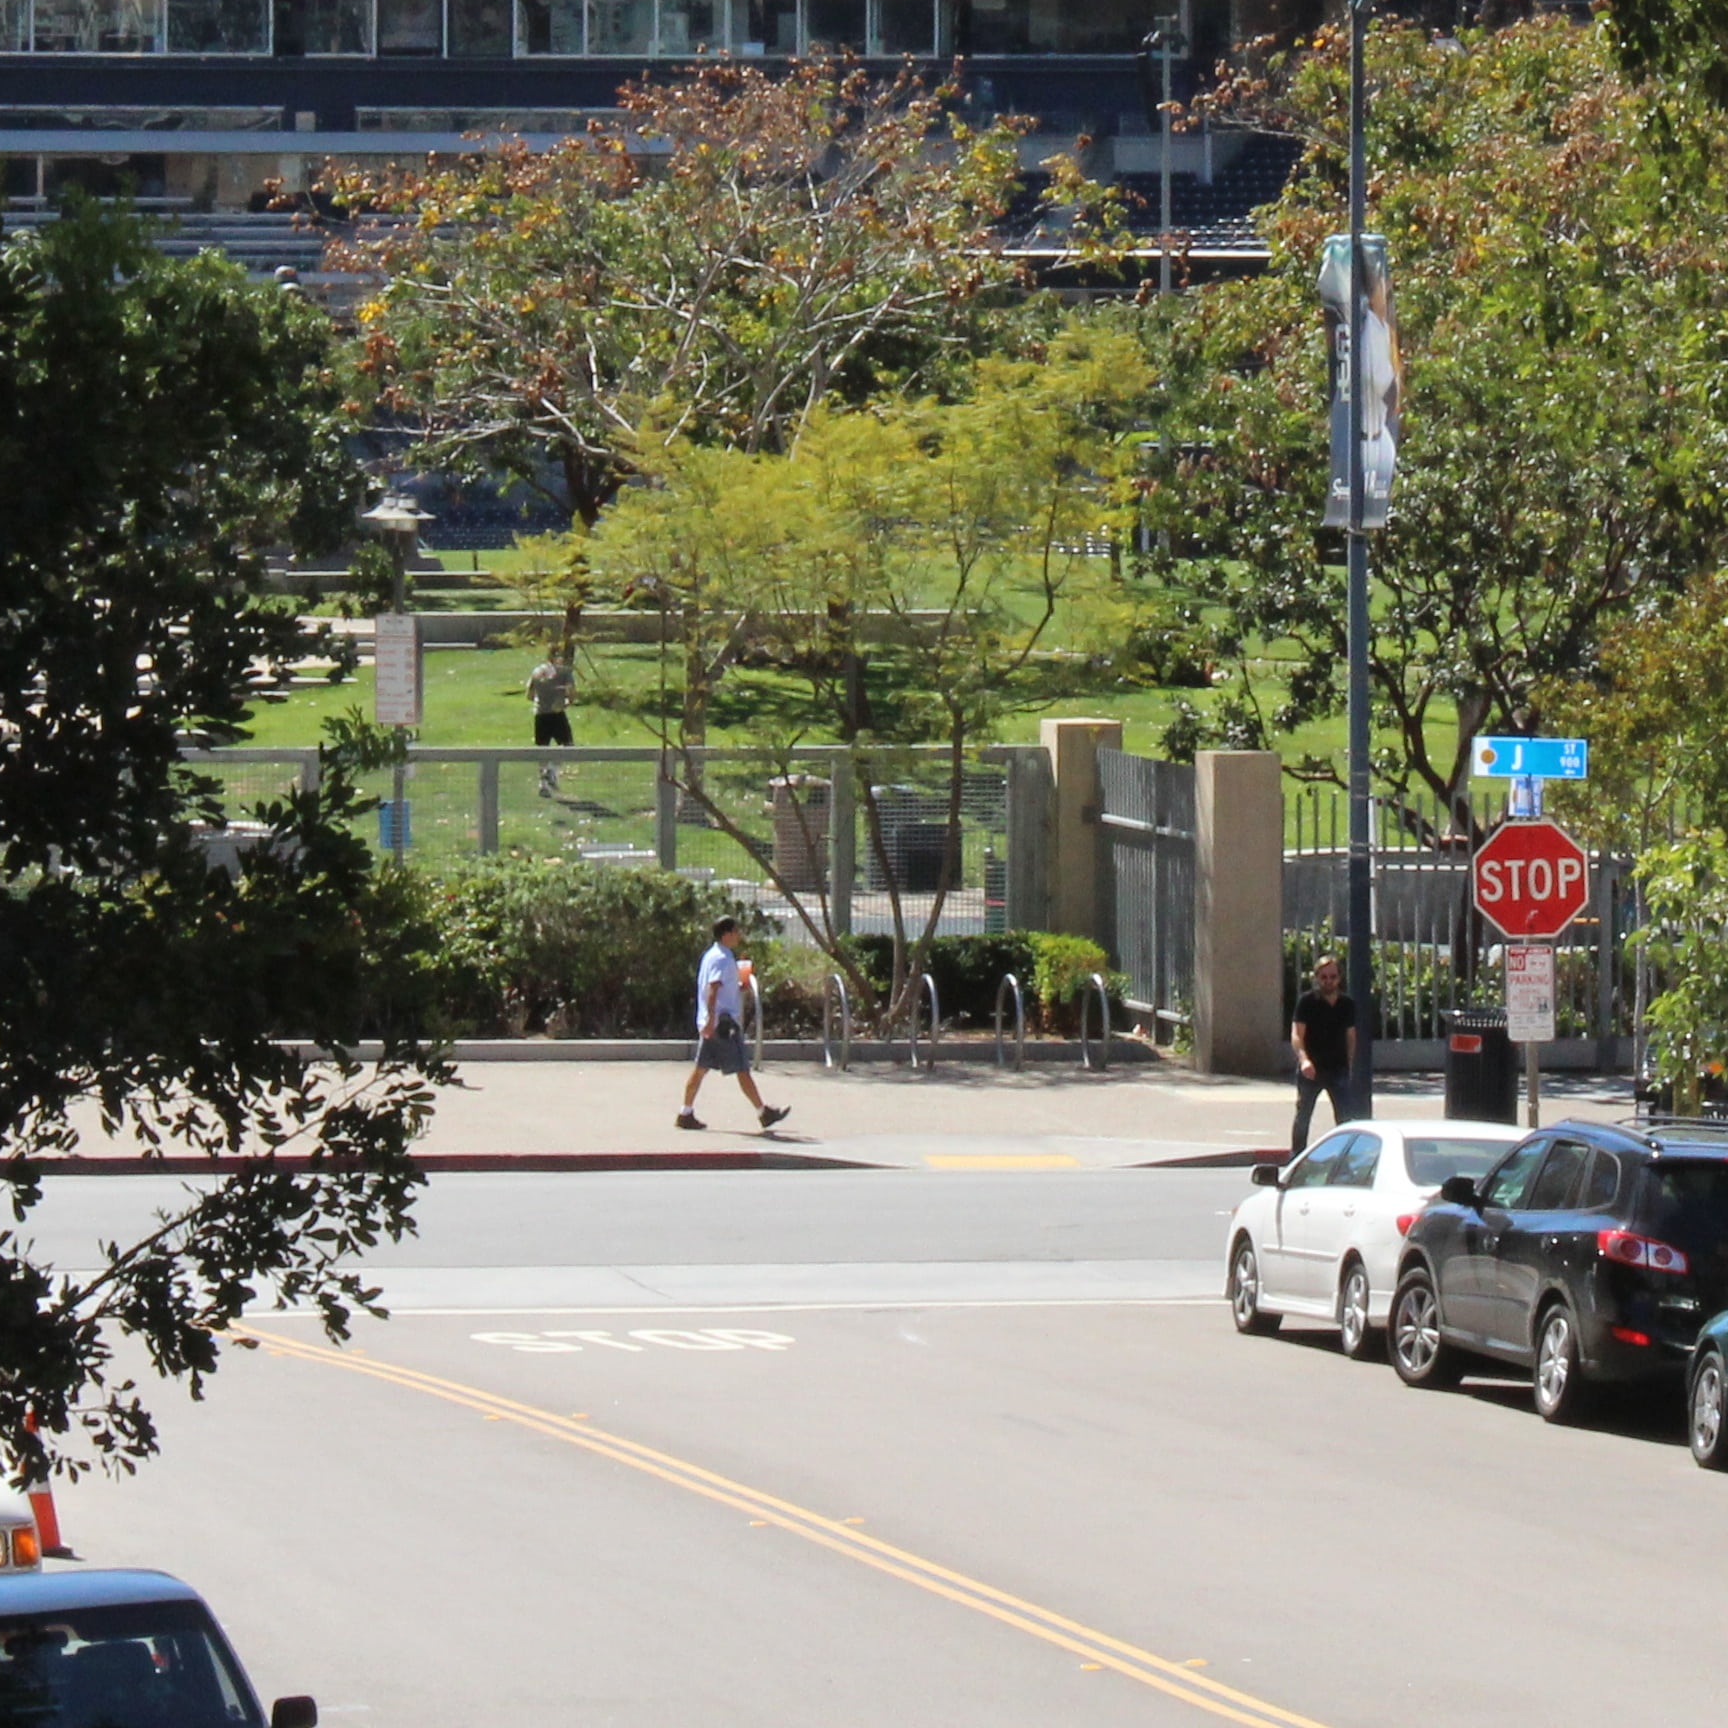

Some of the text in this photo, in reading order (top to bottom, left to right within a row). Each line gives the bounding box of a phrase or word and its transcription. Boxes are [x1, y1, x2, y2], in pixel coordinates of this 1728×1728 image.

[1511, 744, 1523, 771] J
[1480, 858, 1582, 902] STOP
[1510, 956, 1525, 970] NO
[470, 1328, 796, 1353] STOP
